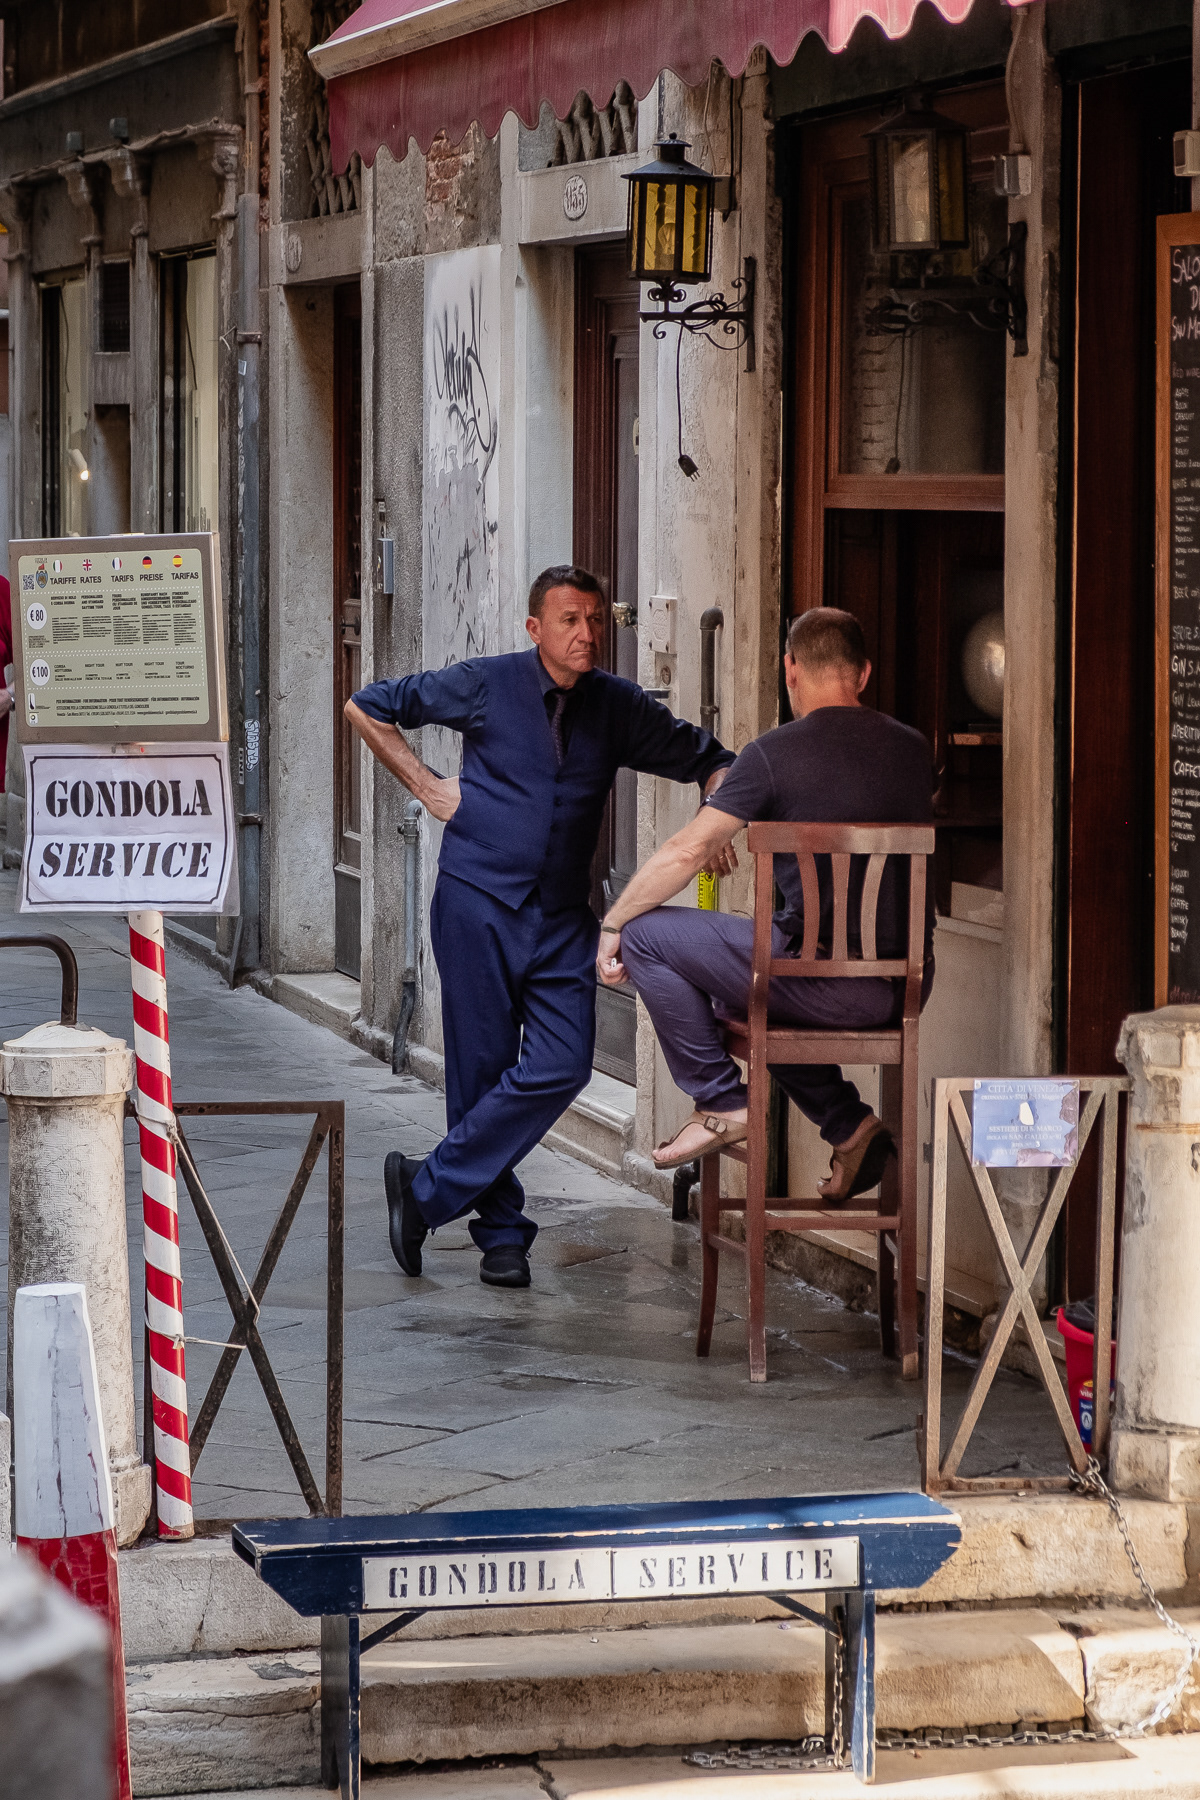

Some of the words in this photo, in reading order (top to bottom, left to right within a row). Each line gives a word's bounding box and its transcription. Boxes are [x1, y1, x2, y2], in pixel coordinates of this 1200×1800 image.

[1189, 285, 1200, 311] D
[50, 577, 76, 585] TARIFFE
[80, 576, 102, 584] RATES
[171, 572, 199, 580] TARIFAS
[36, 609, 43, 621] 80
[1172, 655, 1187, 677] GIN
[45, 779, 213, 817] GONDOLA
[38, 842, 212, 877] SERVICE
[1017, 1084, 1026, 1092] DI
[1028, 1084, 1065, 1092] VENEZIA
[1035, 1140, 1040, 1148] 3
[388, 1558, 586, 1599] GONDOLA
[639, 1548, 833, 1588] SERVICE
